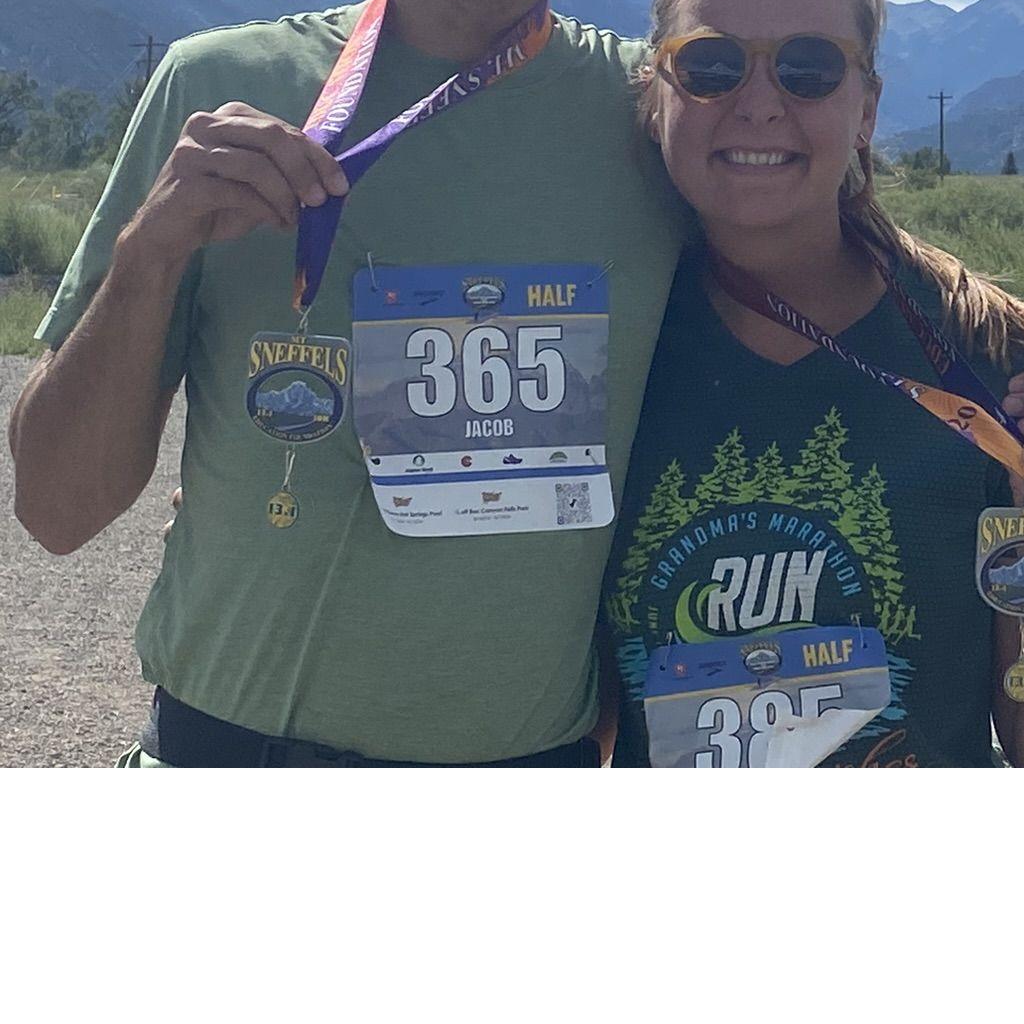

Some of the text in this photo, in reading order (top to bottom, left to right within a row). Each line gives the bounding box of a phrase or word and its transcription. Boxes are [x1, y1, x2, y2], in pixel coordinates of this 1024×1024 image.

[527, 283, 577, 308] HALF
[248, 340, 348, 386] SNEFFELS
[404, 324, 567, 419] 365
[464, 418, 515, 439] JACOB
[650, 510, 862, 597] GRANDMA'S MARATHON
[707, 548, 829, 632] RUN
[802, 638, 853, 667] HALF
